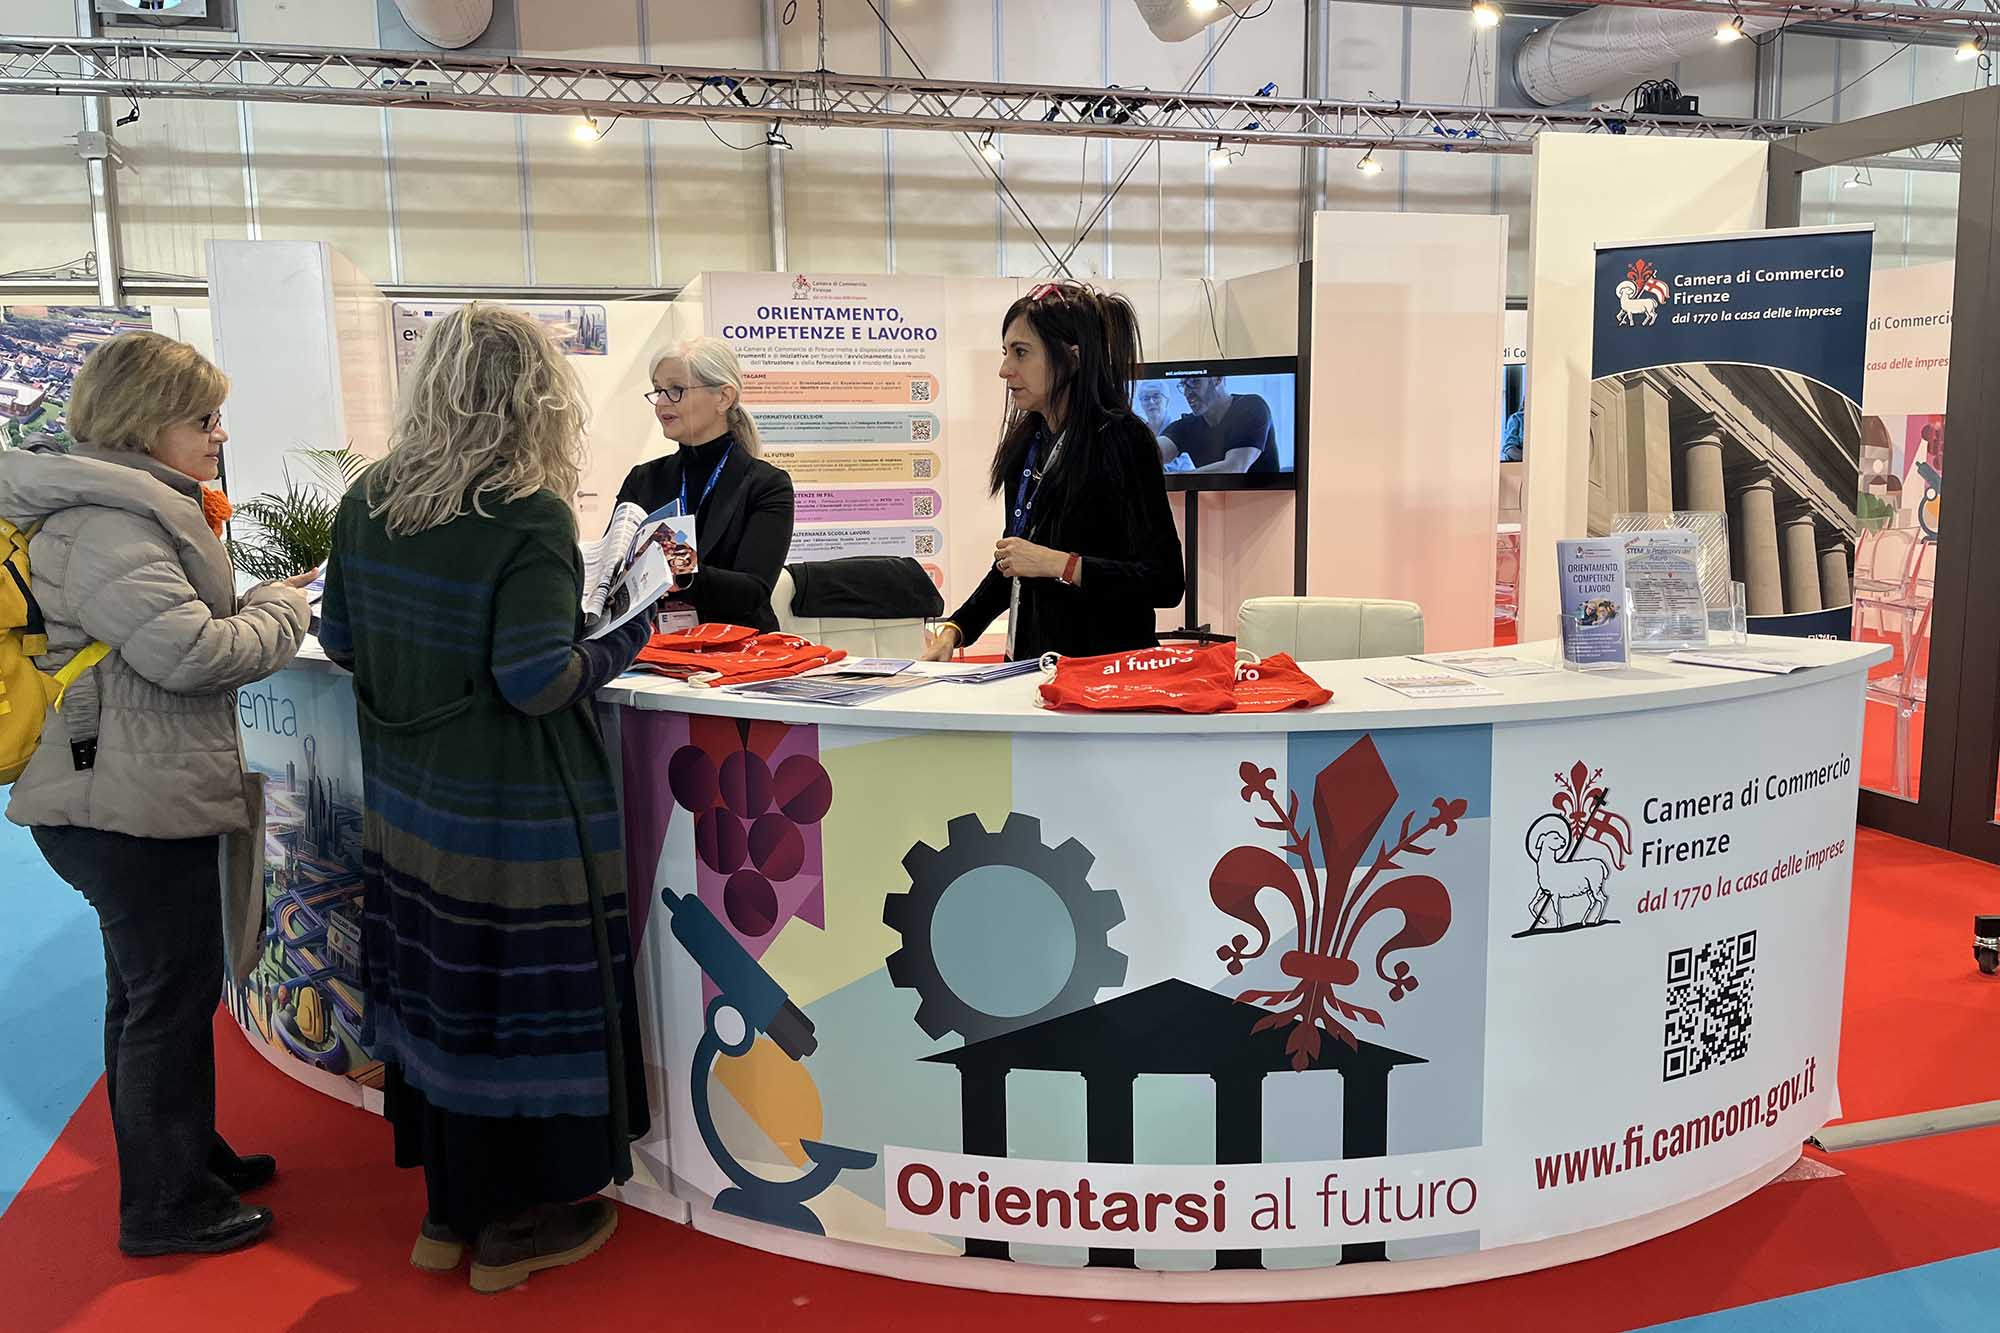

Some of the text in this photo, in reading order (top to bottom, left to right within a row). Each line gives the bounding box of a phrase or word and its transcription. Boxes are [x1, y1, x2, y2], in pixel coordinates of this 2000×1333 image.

[1674, 265, 1845, 287] Camera di Commercio
[1673, 291, 1730, 305] Firenze
[756, 306, 904, 324] ORIENTAMENTO,
[1671, 305, 1843, 325] dal 1770 la casa delle imprese
[1869, 310, 1953, 331] di Commerci
[722, 325, 938, 341] COMPETENZE E LAVORO
[1514, 347, 1527, 358] Co
[1866, 361, 1887, 371] casa
[1889, 358, 1912, 370] delle
[1573, 573, 1616, 584] COMPETENZE
[1584, 584, 1611, 594] LAVORO
[662, 614, 669, 623] E
[1103, 660, 1120, 676] al
[238, 682, 298, 738] enta
[1642, 752, 1851, 825] Camera di Commercio
[1641, 831, 1731, 868] Firenze
[1637, 838, 1846, 914] dal 1770 la casa delle imprese
[1535, 1055, 1817, 1190] www.fi.camcom.gov.it
[896, 1162, 1478, 1233] Orientarsi al futuro
